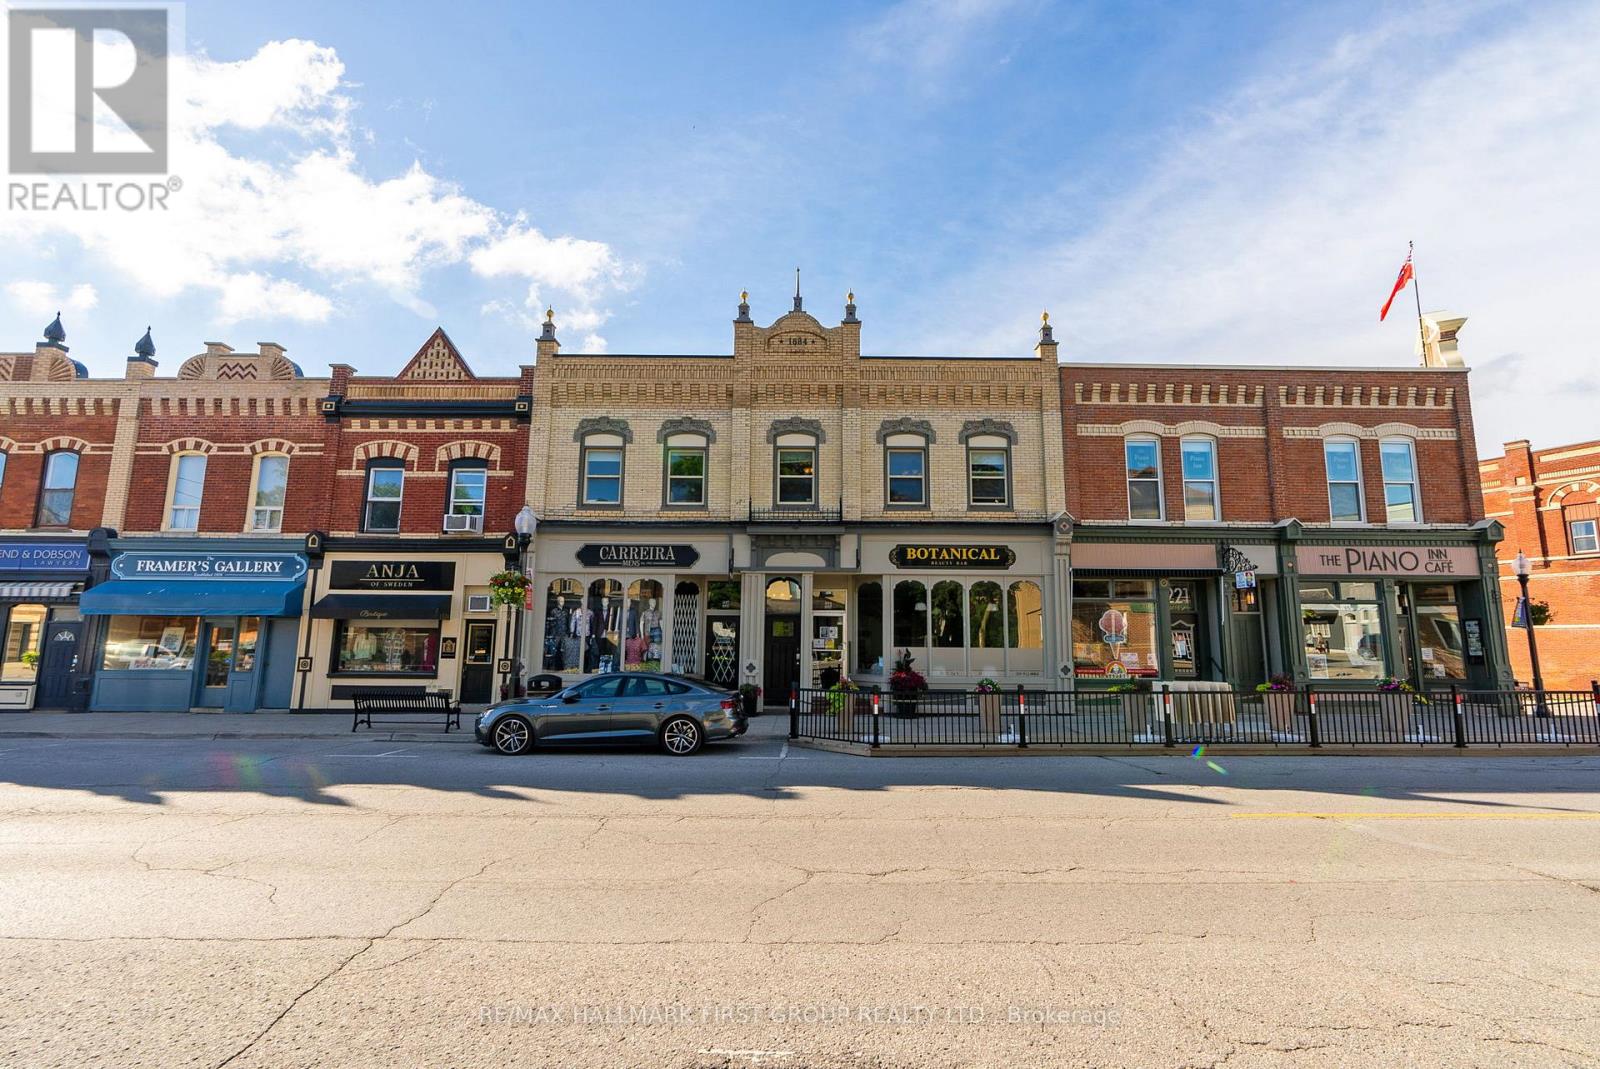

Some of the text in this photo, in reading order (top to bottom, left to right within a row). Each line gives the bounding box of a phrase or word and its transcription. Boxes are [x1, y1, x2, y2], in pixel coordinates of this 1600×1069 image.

[22, 550, 31, 559] &
[33, 549, 83, 559] DOBSON
[599, 545, 676, 561] CARREIRA
[906, 547, 1000, 561] BOTANICAL
[1427, 548, 1448, 560] INN
[136, 560, 284, 573] FRAMER'S GALLERY
[1319, 548, 1419, 574] THE PIANO
[365, 564, 420, 579] ANJA
